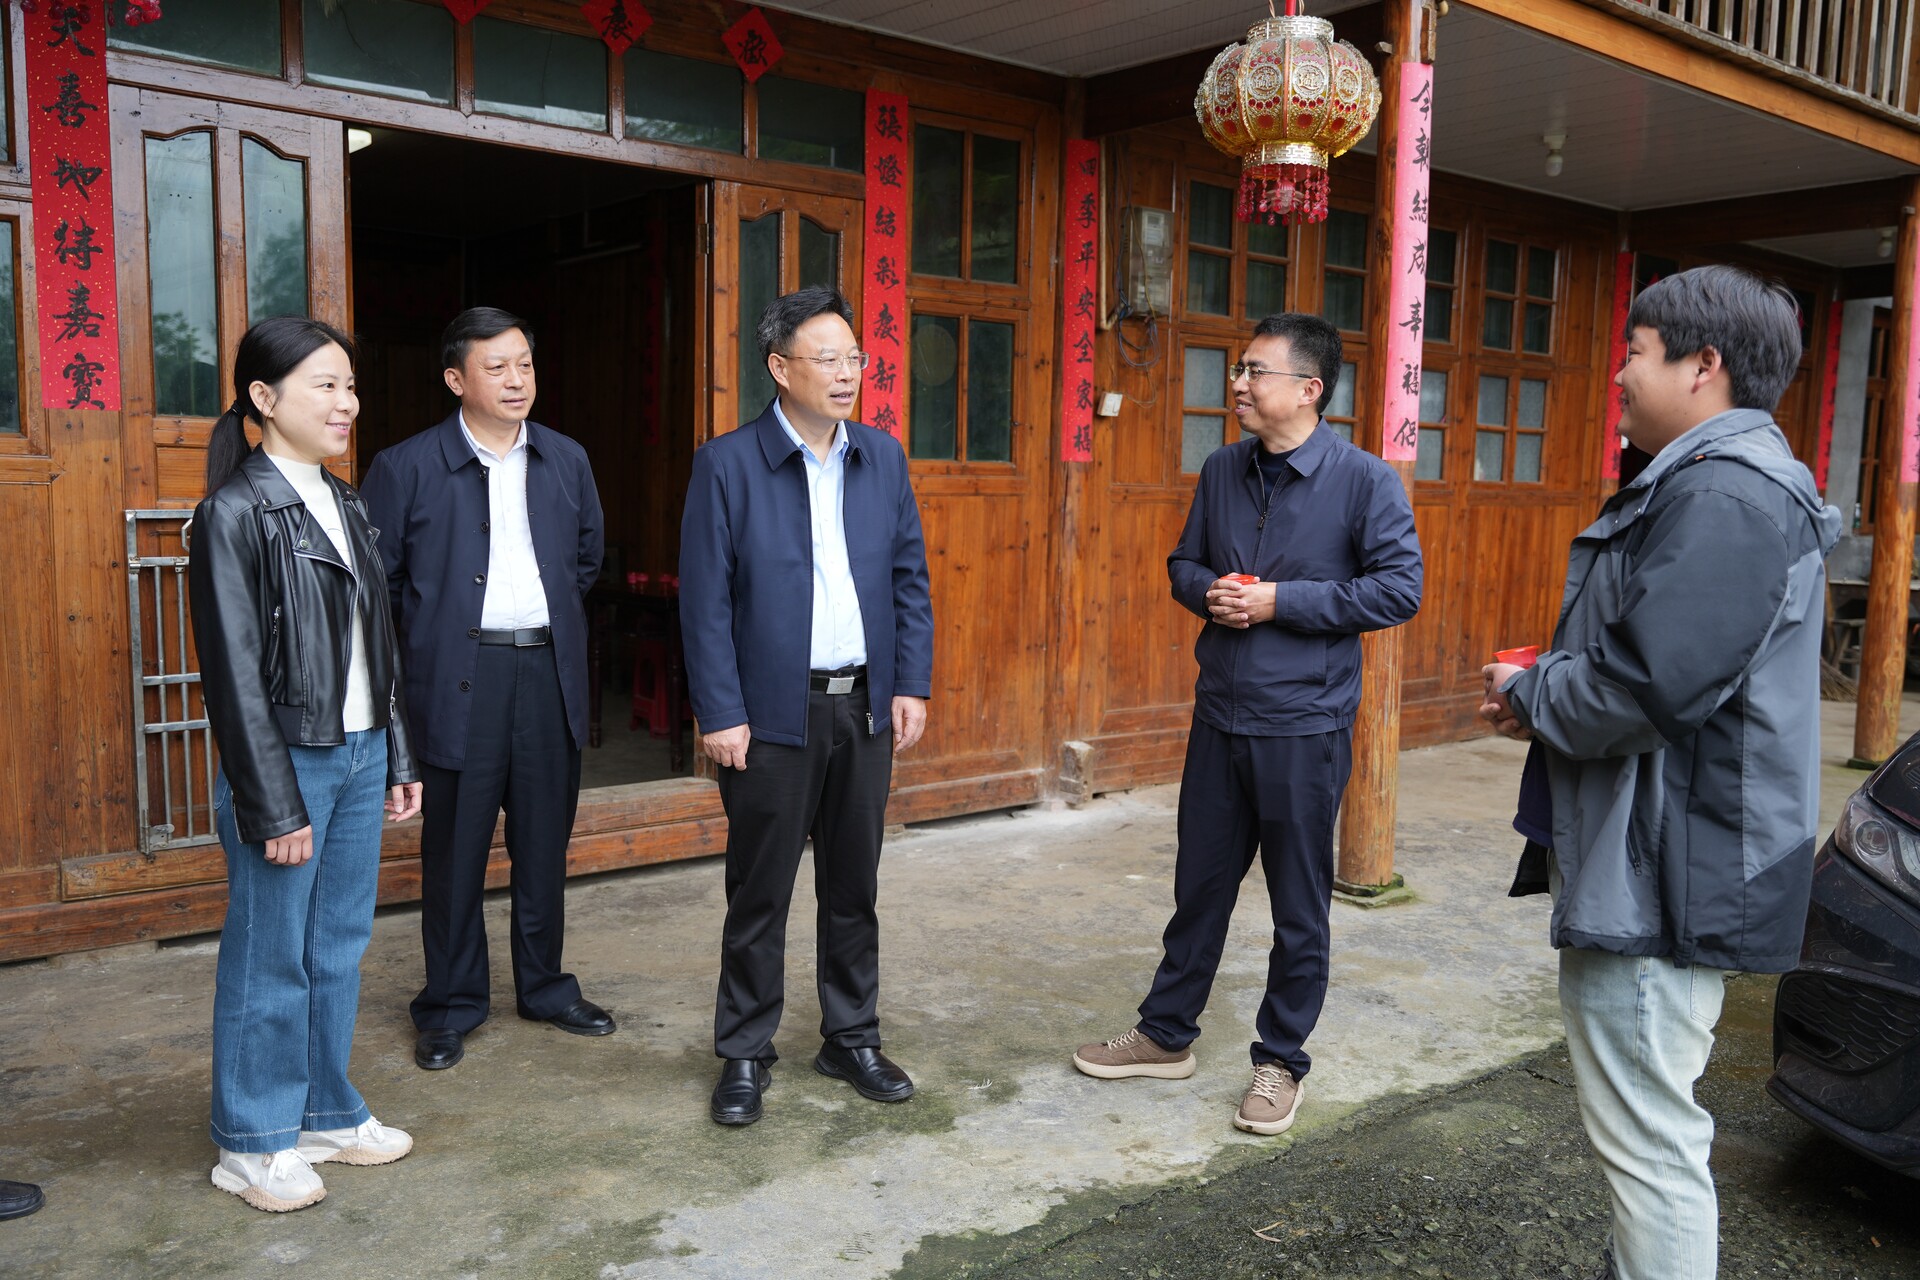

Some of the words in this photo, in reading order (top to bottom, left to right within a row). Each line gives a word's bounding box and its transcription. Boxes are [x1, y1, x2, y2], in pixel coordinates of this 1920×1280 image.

[1074, 158, 1097, 453] 四季平安全家福
